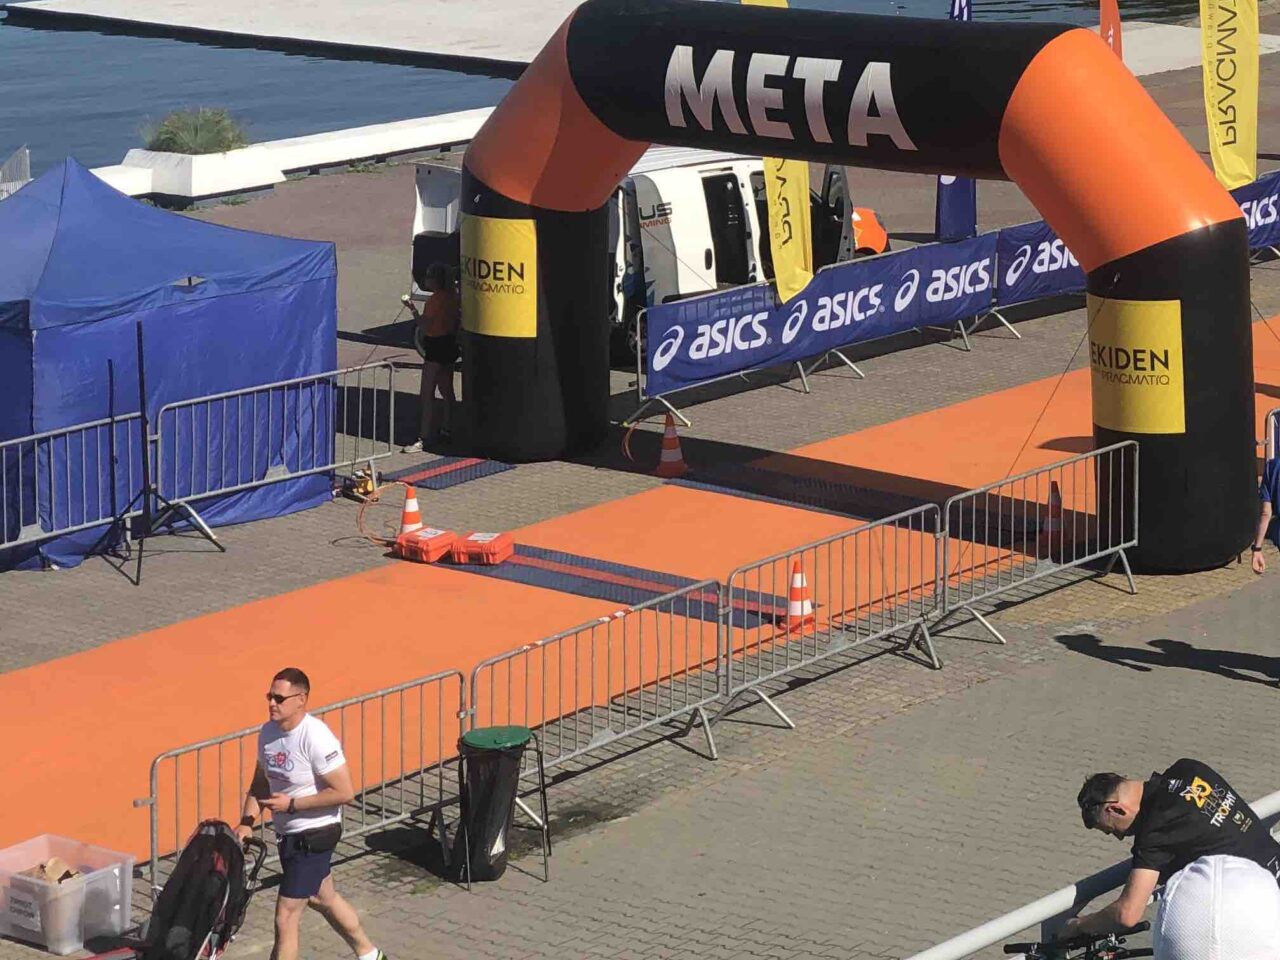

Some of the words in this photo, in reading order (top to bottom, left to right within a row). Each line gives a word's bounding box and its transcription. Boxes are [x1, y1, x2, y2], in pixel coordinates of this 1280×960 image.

[664, 44, 918, 151] META
[1245, 194, 1278, 229] sics
[1033, 237, 1079, 274] asi
[926, 258, 990, 302] asics
[812, 283, 880, 332] asics
[689, 311, 769, 360] asics
[1090, 341, 1169, 371] EKIDEN
[1210, 790, 1237, 827] TROPHY
